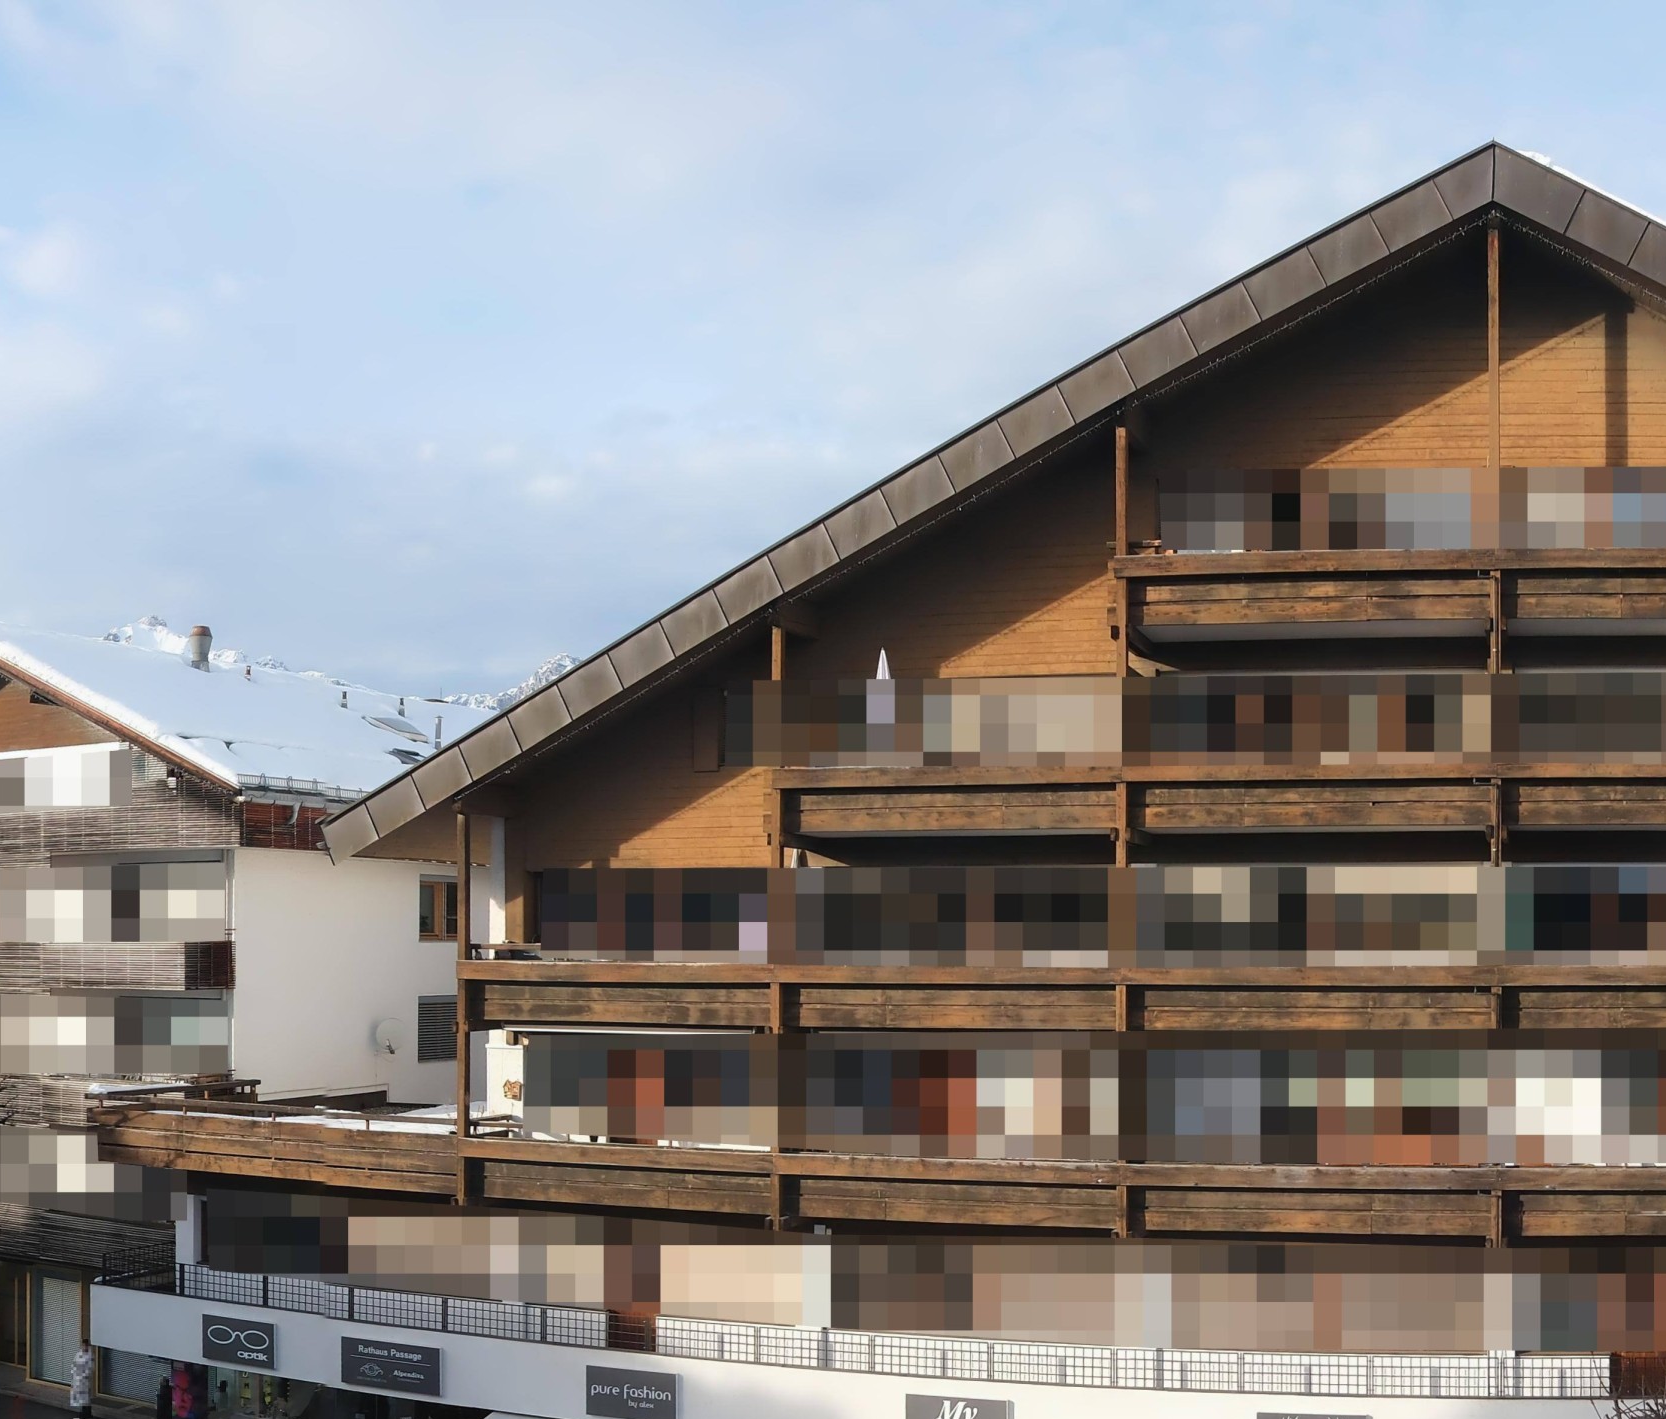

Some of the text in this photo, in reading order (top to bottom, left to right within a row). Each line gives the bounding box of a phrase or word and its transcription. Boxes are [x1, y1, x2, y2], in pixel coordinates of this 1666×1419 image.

[237, 1350, 268, 1361] optik
[358, 1345, 422, 1361] Rathaus Passage
[591, 1384, 672, 1401] pure fashion
[628, 1400, 637, 1409] by
